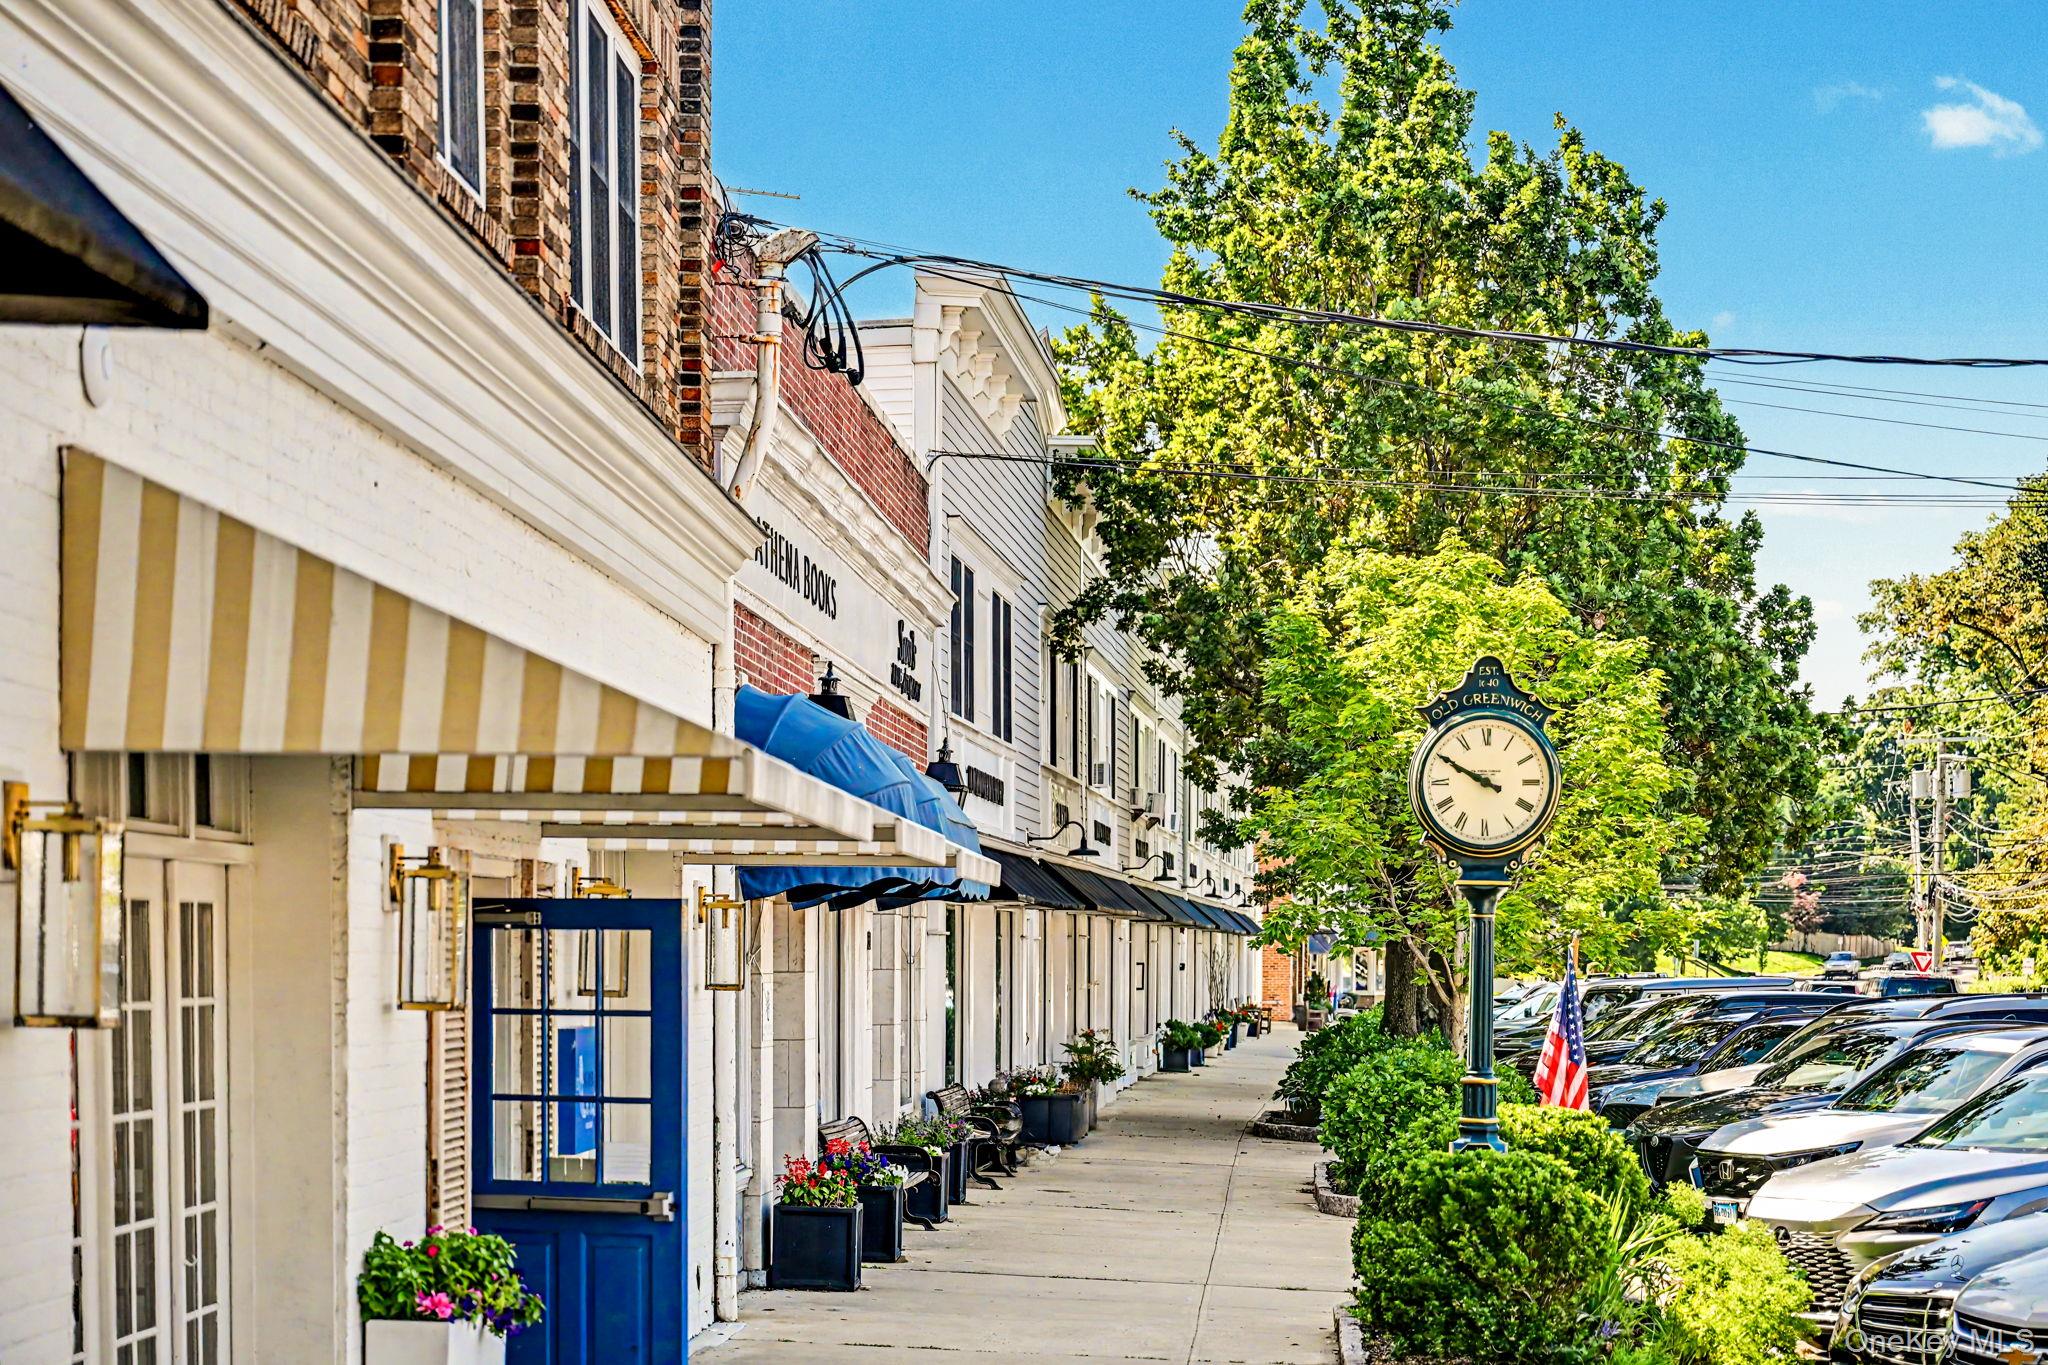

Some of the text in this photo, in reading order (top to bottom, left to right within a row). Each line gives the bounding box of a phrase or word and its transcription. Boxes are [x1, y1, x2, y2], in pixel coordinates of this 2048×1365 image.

[803, 555, 837, 620] BOOKS
[1479, 666, 1499, 676] EST.
[1431, 692, 1544, 722] OLD GREENWICH
